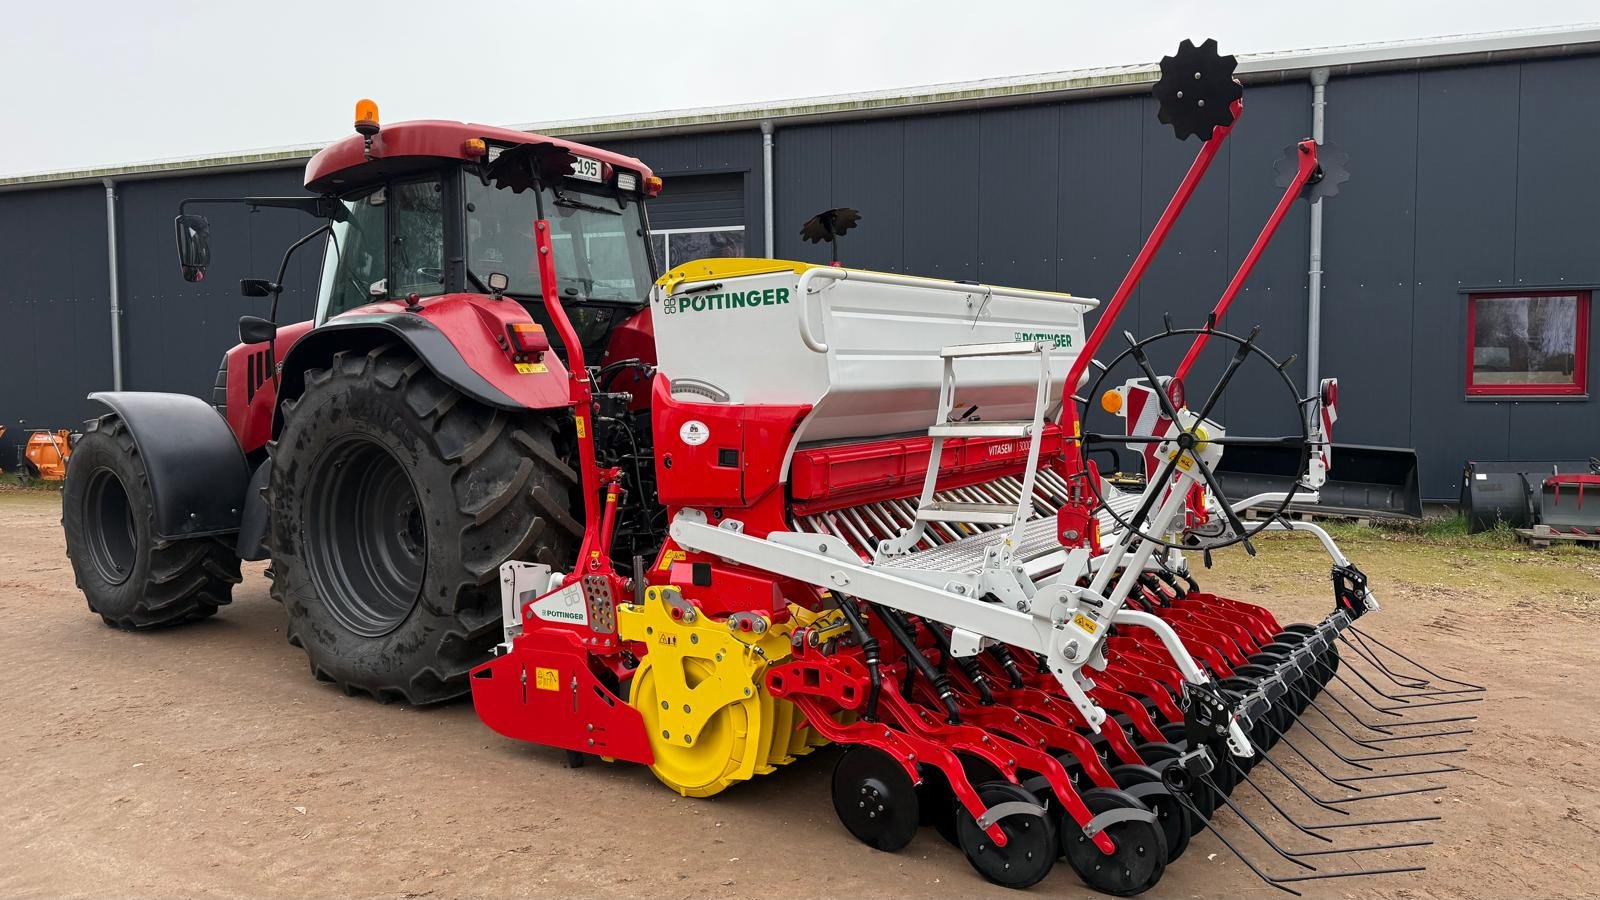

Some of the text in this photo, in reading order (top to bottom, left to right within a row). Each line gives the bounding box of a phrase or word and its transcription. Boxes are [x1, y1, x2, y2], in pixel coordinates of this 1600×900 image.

[577, 159, 597, 176] 195
[679, 287, 790, 312] PÖTTINGER
[988, 443, 1013, 456] VITASEM
